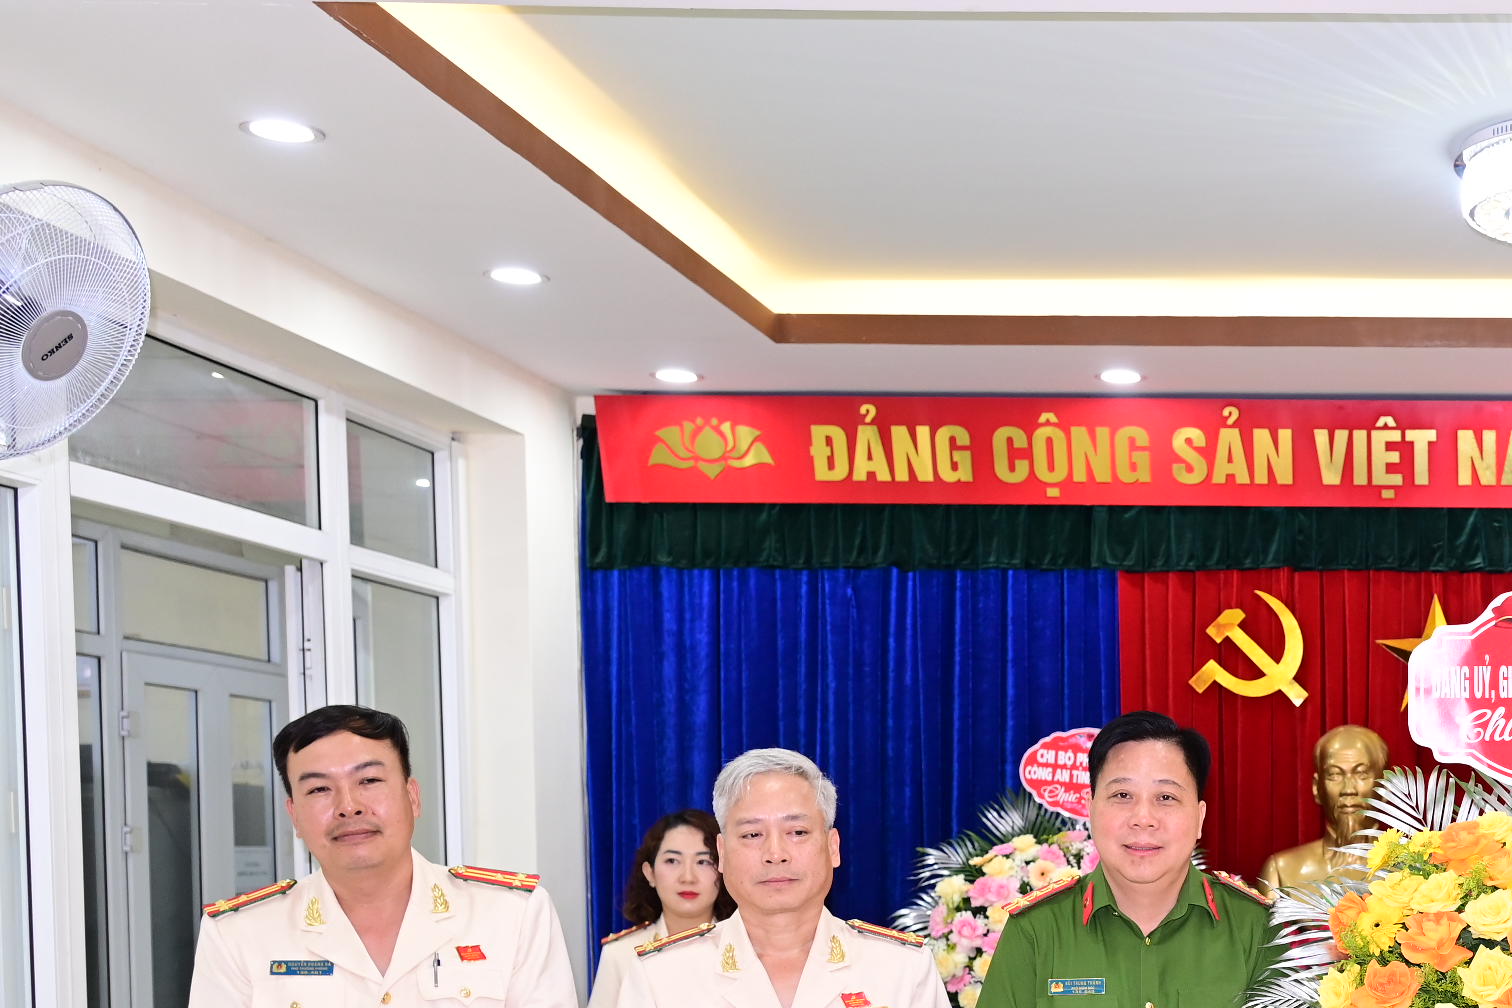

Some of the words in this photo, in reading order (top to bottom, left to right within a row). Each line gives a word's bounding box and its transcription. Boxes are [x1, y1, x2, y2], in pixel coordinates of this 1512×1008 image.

[41, 333, 74, 361] SENKO
[810, 404, 974, 484] ĐẢNG
[993, 412, 1153, 498] CỘNG
[1172, 407, 1295, 486] SẢN
[1314, 416, 1438, 499] VIỆT
[1037, 749, 1056, 764] CHI
[1025, 764, 1053, 781] CÔNG
[1054, 769, 1071, 782] AN
